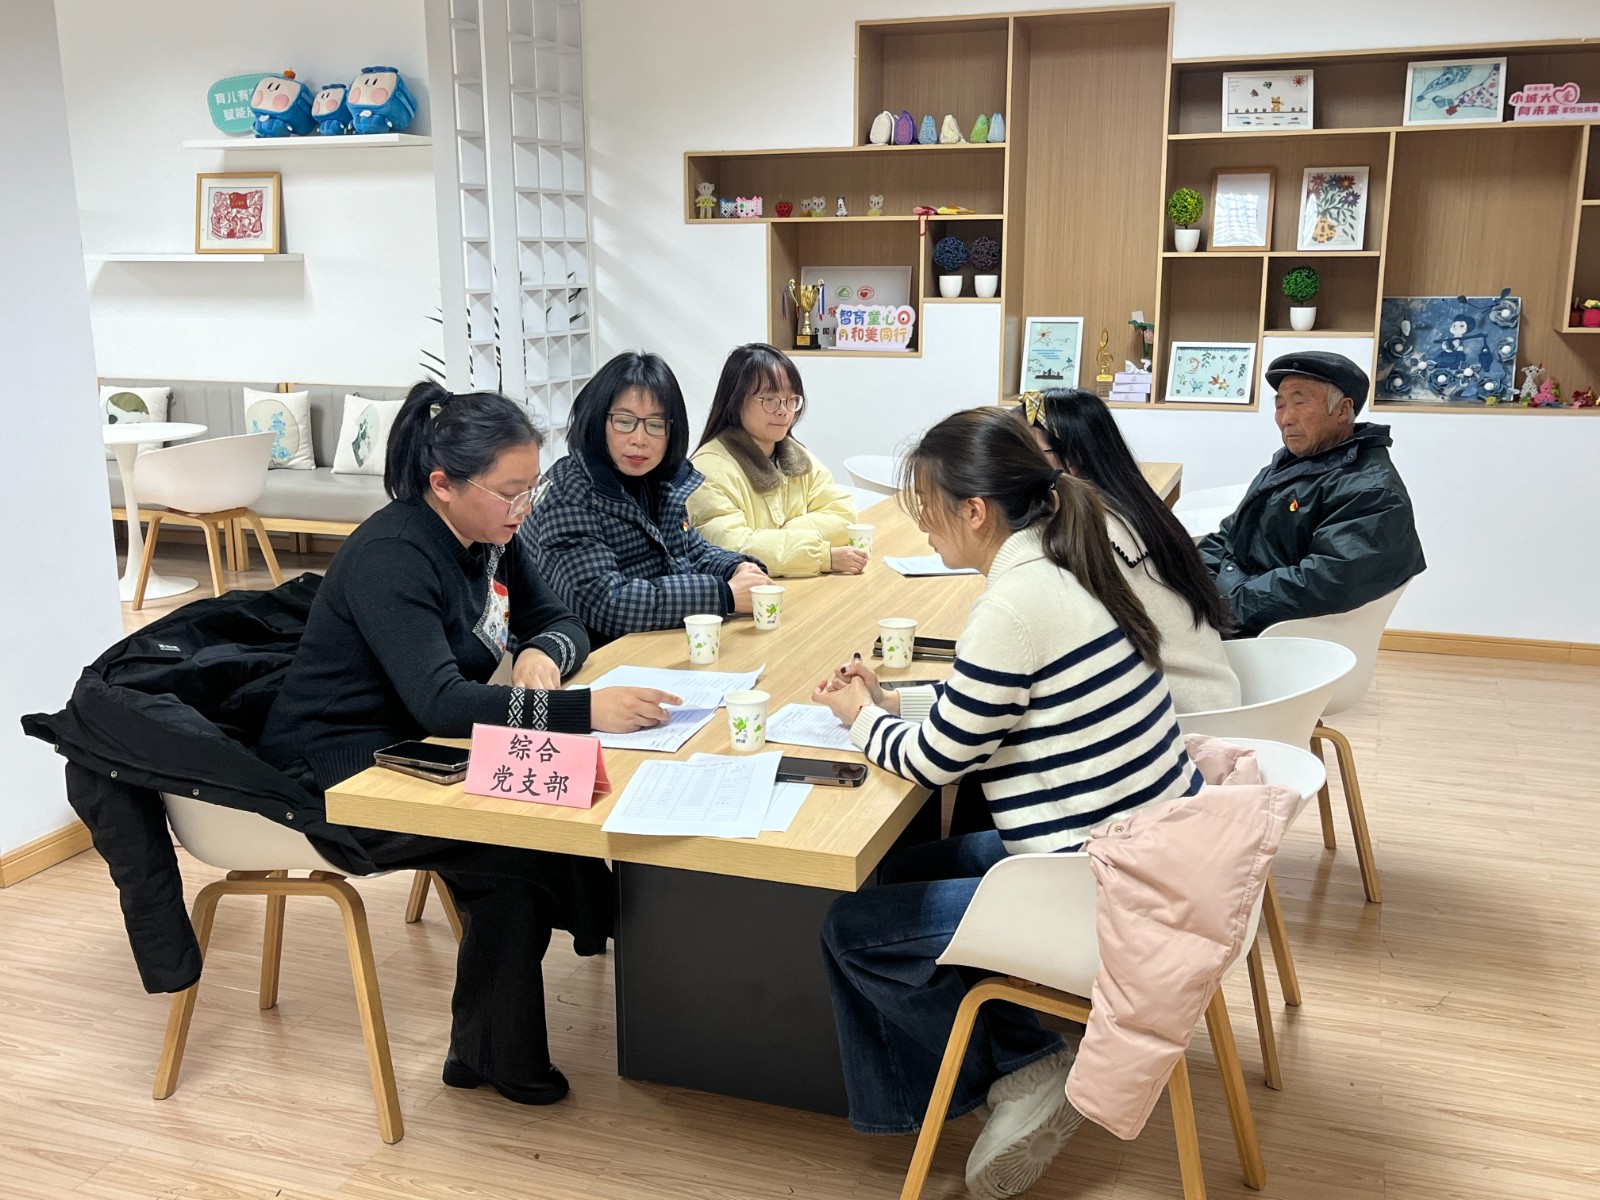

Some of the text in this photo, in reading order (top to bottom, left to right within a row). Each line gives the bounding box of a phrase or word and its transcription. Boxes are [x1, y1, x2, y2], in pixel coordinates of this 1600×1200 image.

[214, 88, 254, 105] 育儿有
[1517, 105, 1560, 116] 向未来
[839, 309, 896, 326] 智育童心
[851, 327, 908, 343] 和美同行
[508, 733, 561, 763] 综合
[490, 764, 570, 801] 党支部
